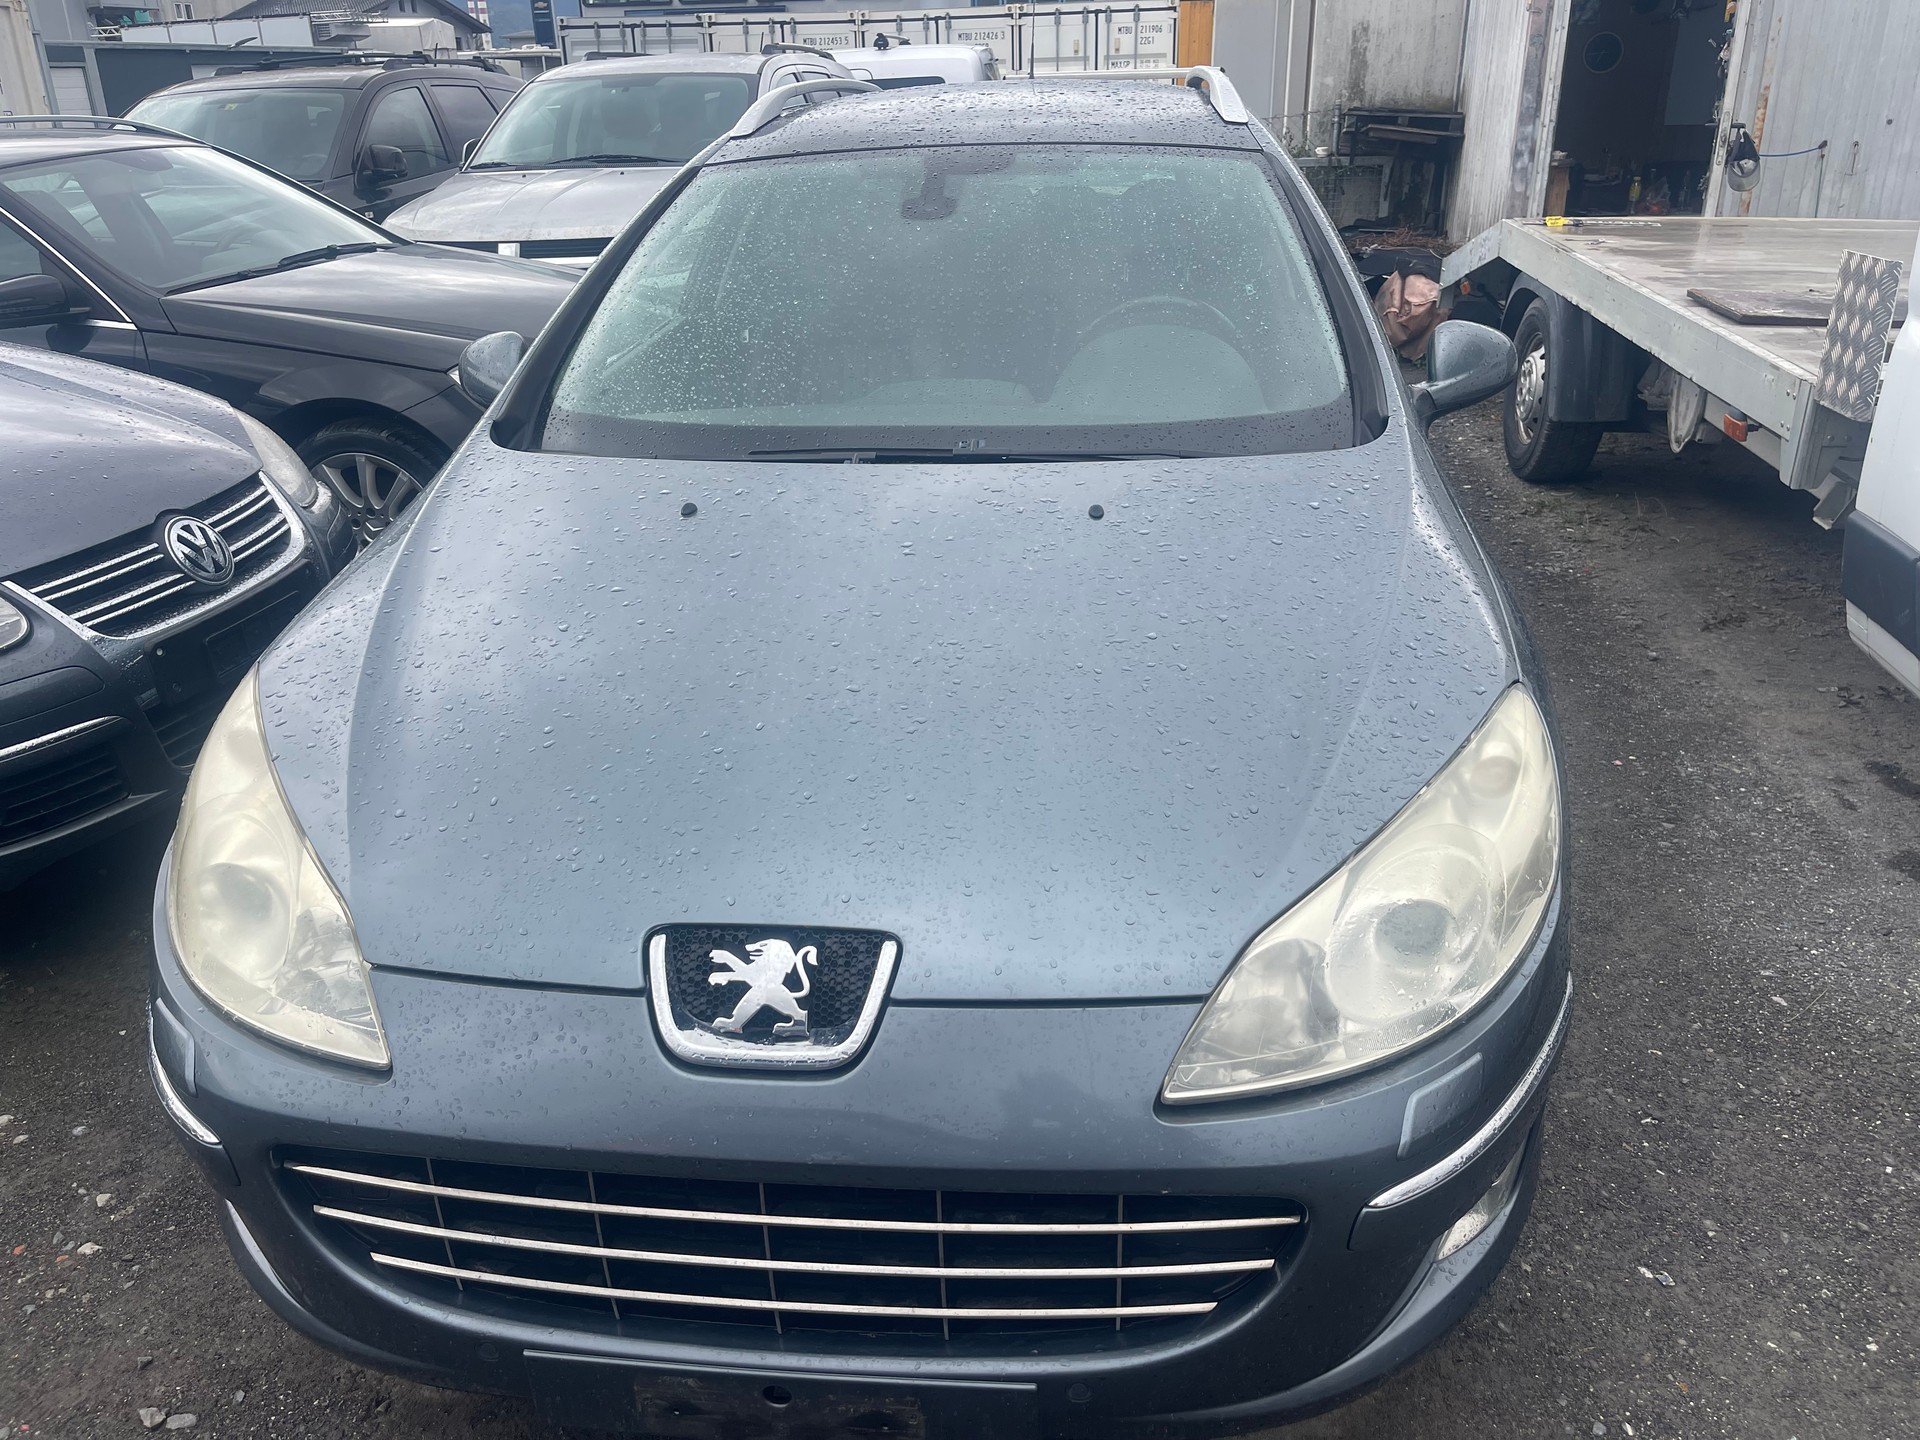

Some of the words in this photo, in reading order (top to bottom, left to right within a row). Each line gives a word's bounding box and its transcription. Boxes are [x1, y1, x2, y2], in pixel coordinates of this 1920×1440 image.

[1117, 26, 1133, 35] MTBU
[1140, 24, 1163, 34] 211906
[802, 37, 817, 45] MTBU
[819, 37, 842, 45] 212453
[958, 32, 972, 41] MTBU
[974, 31, 998, 40] 212426
[167, 517, 232, 581] VW
